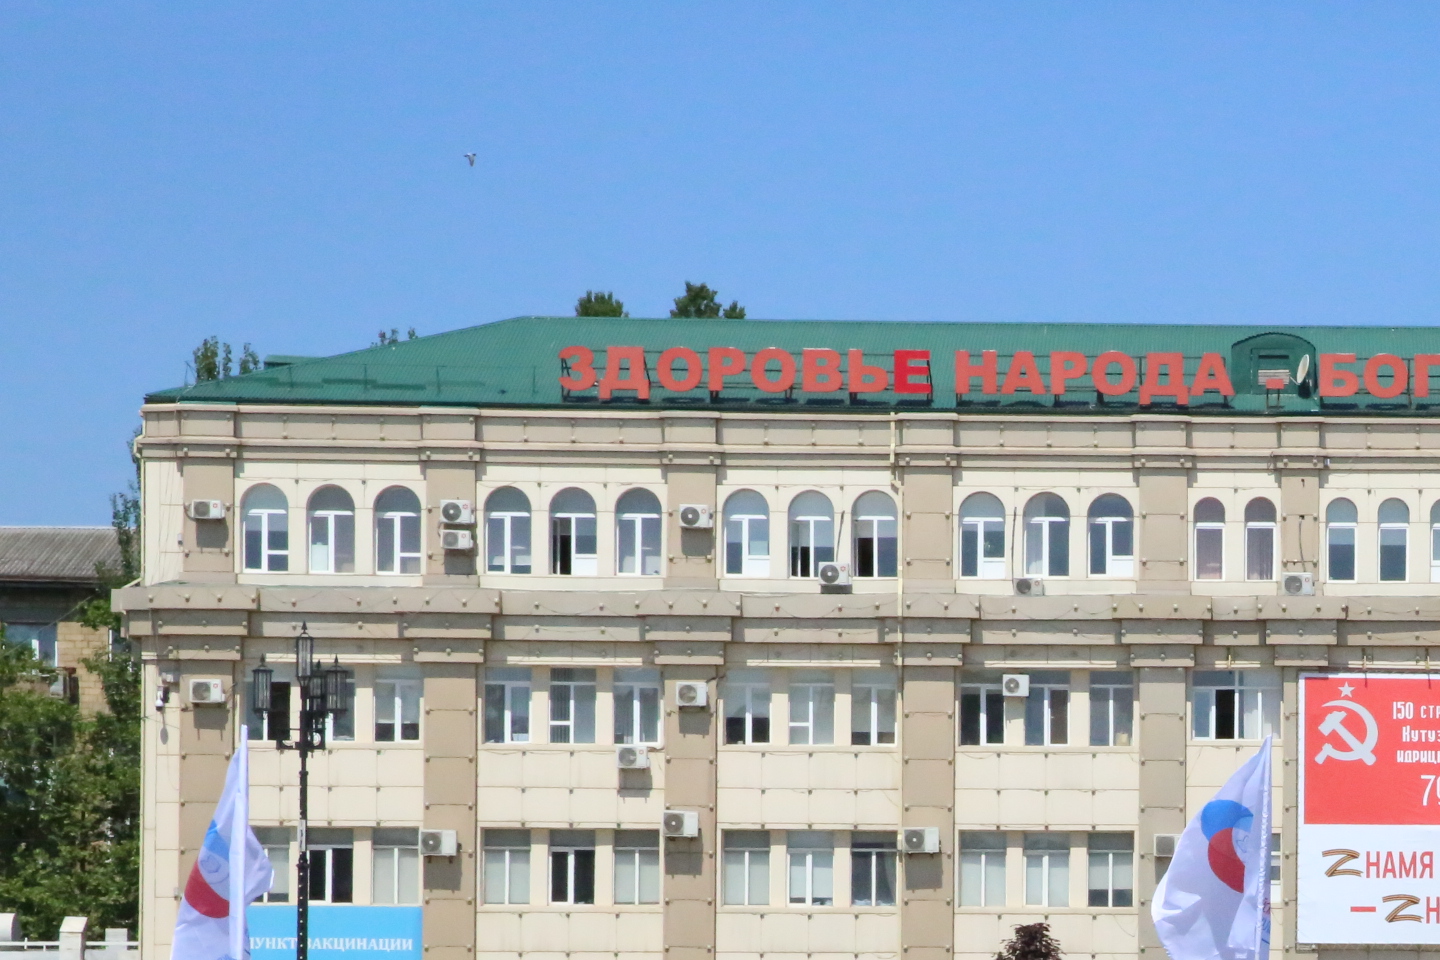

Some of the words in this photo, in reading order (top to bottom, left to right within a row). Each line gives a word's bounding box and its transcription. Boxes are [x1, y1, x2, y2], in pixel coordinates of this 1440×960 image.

[558, 346, 931, 400] ЗДОРОВЬЕ
[954, 349, 1235, 405] НАРОДА
[1392, 701, 1414, 720] 150
